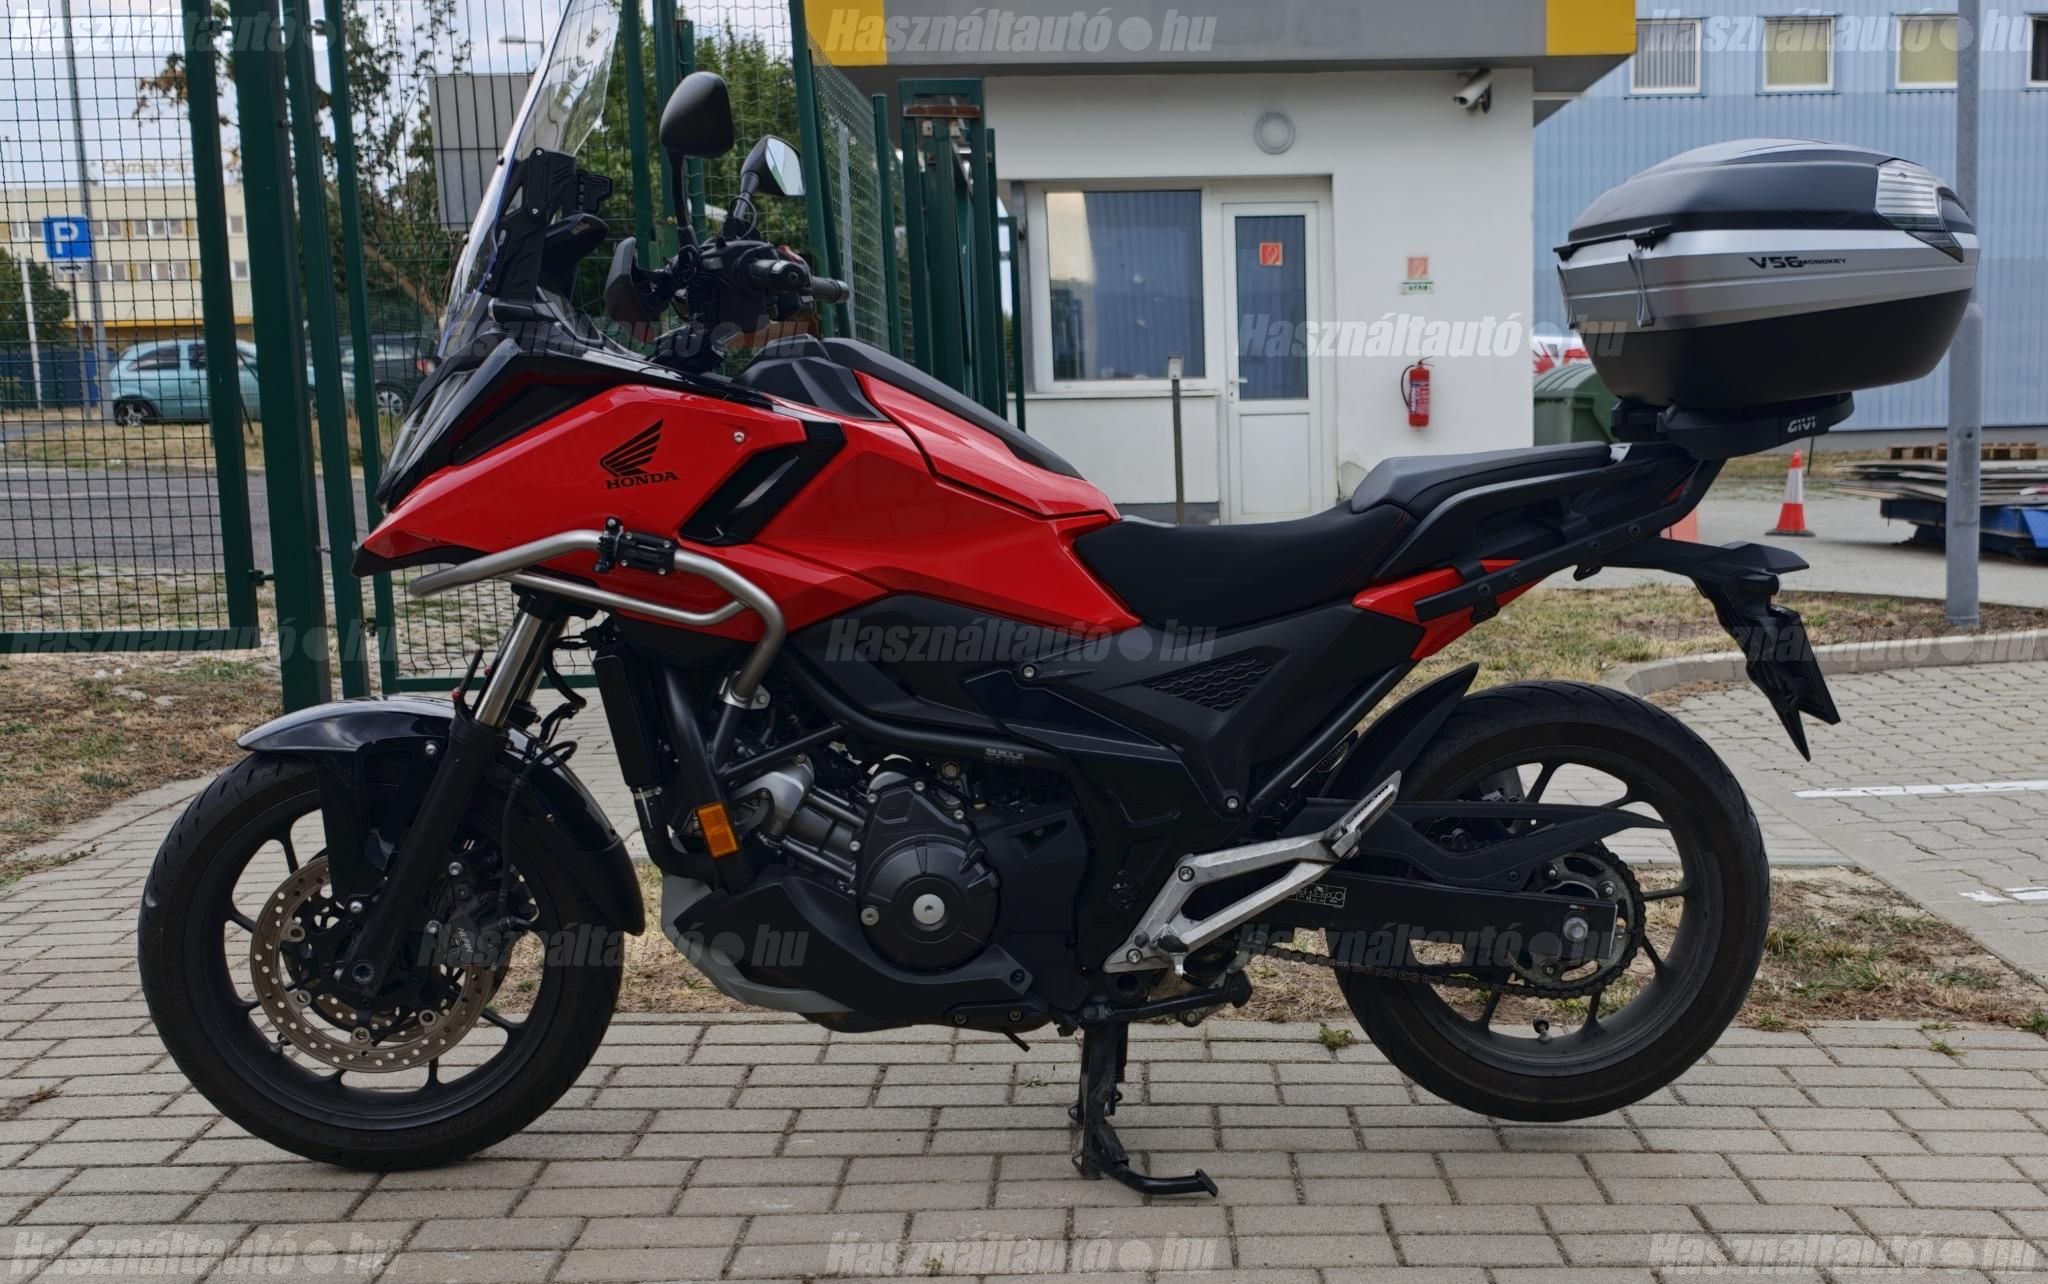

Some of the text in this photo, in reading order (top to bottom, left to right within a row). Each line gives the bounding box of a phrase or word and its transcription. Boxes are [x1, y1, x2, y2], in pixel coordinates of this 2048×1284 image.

[53, 221, 79, 255] P
[1747, 256, 1804, 269] V56
[1787, 415, 1816, 433] GIVI
[605, 470, 680, 490] HONDA
